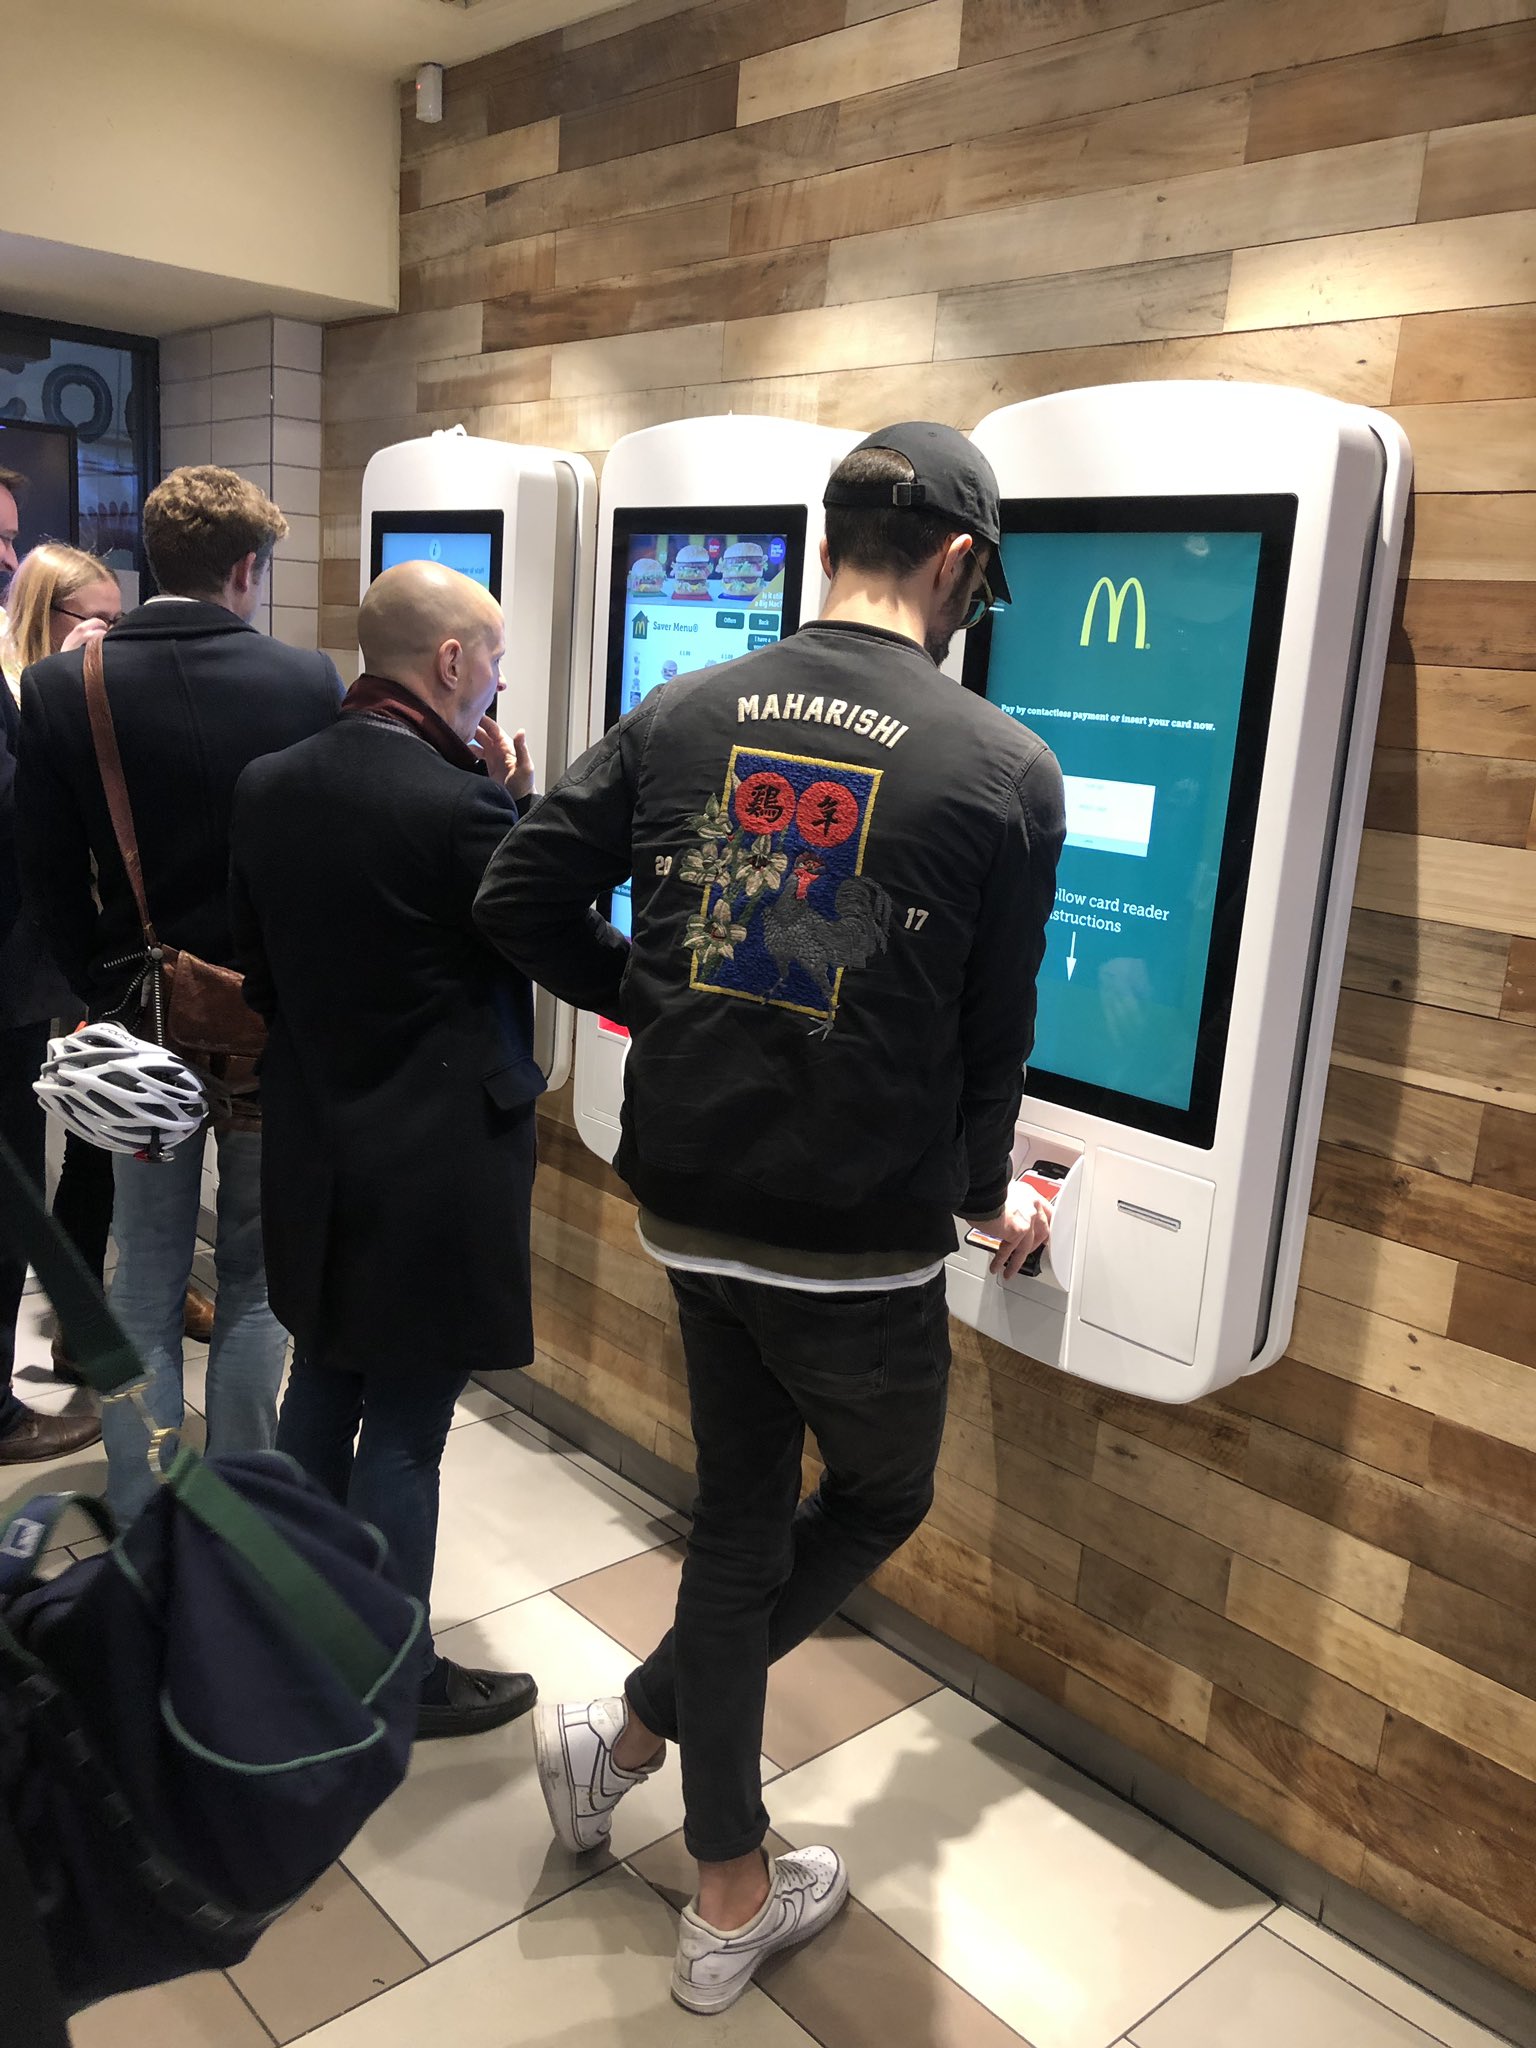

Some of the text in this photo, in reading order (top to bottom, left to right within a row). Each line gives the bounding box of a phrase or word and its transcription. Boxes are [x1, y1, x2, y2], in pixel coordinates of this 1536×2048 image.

[653, 621, 671, 631] Saver
[737, 693, 909, 749] MAHARISHI
[1001, 704, 1015, 715] Pay
[1016, 705, 1026, 715] by
[1027, 708, 1072, 718] contactless
[1072, 711, 1109, 721] payment
[1121, 714, 1147, 725] insert
[1148, 718, 1170, 727] your
[1171, 720, 1191, 729] card
[1193, 722, 1216, 731] now.
[655, 855, 673, 876] 20
[1055, 888, 1170, 921] llow card reader
[904, 907, 930, 931] 17
